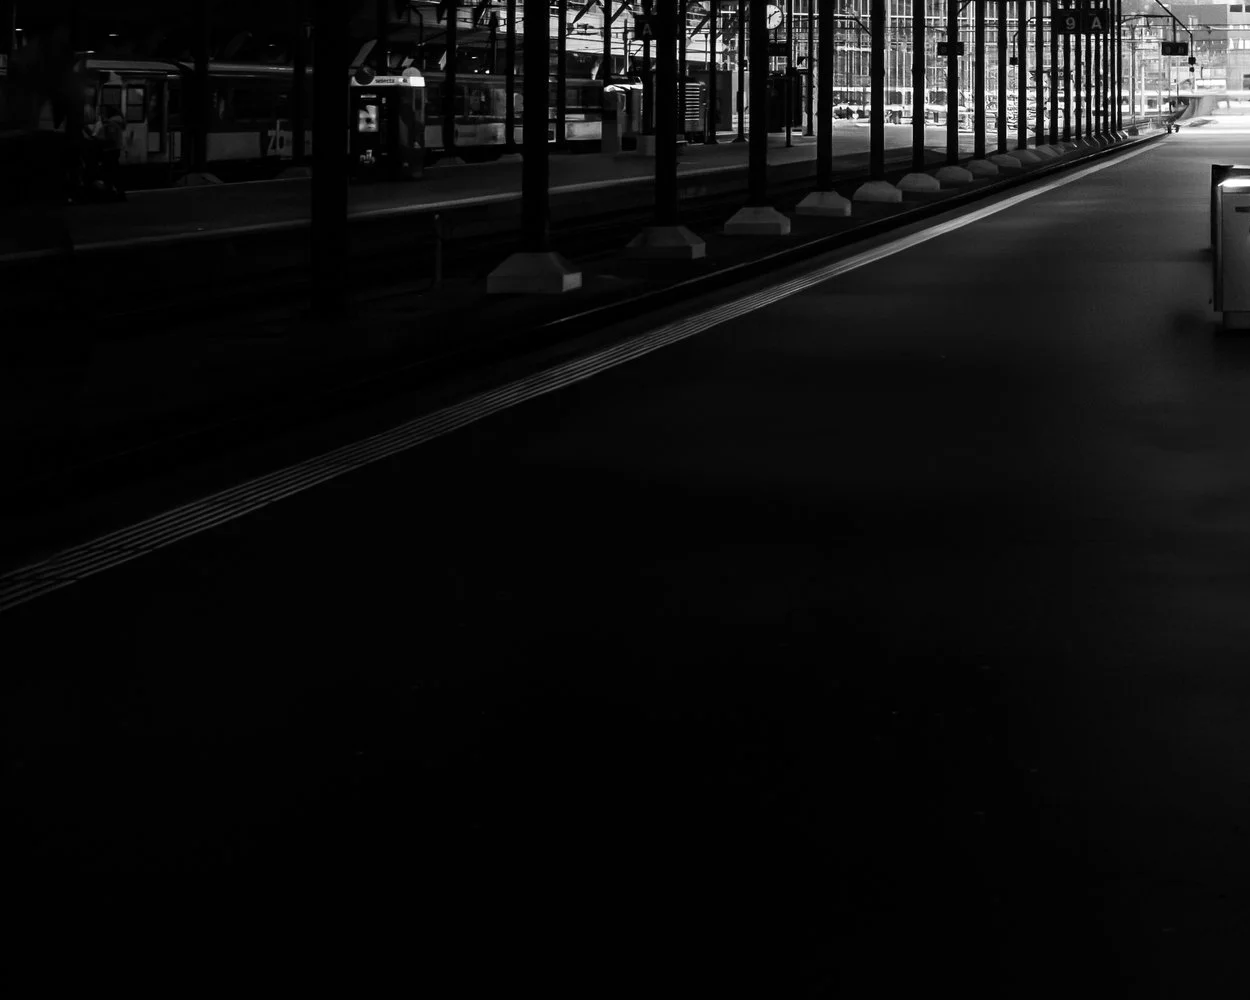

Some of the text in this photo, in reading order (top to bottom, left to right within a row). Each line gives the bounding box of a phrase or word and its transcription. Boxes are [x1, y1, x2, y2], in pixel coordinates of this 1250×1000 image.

[642, 23, 653, 36] A
[1065, 15, 1102, 30] 9 A
